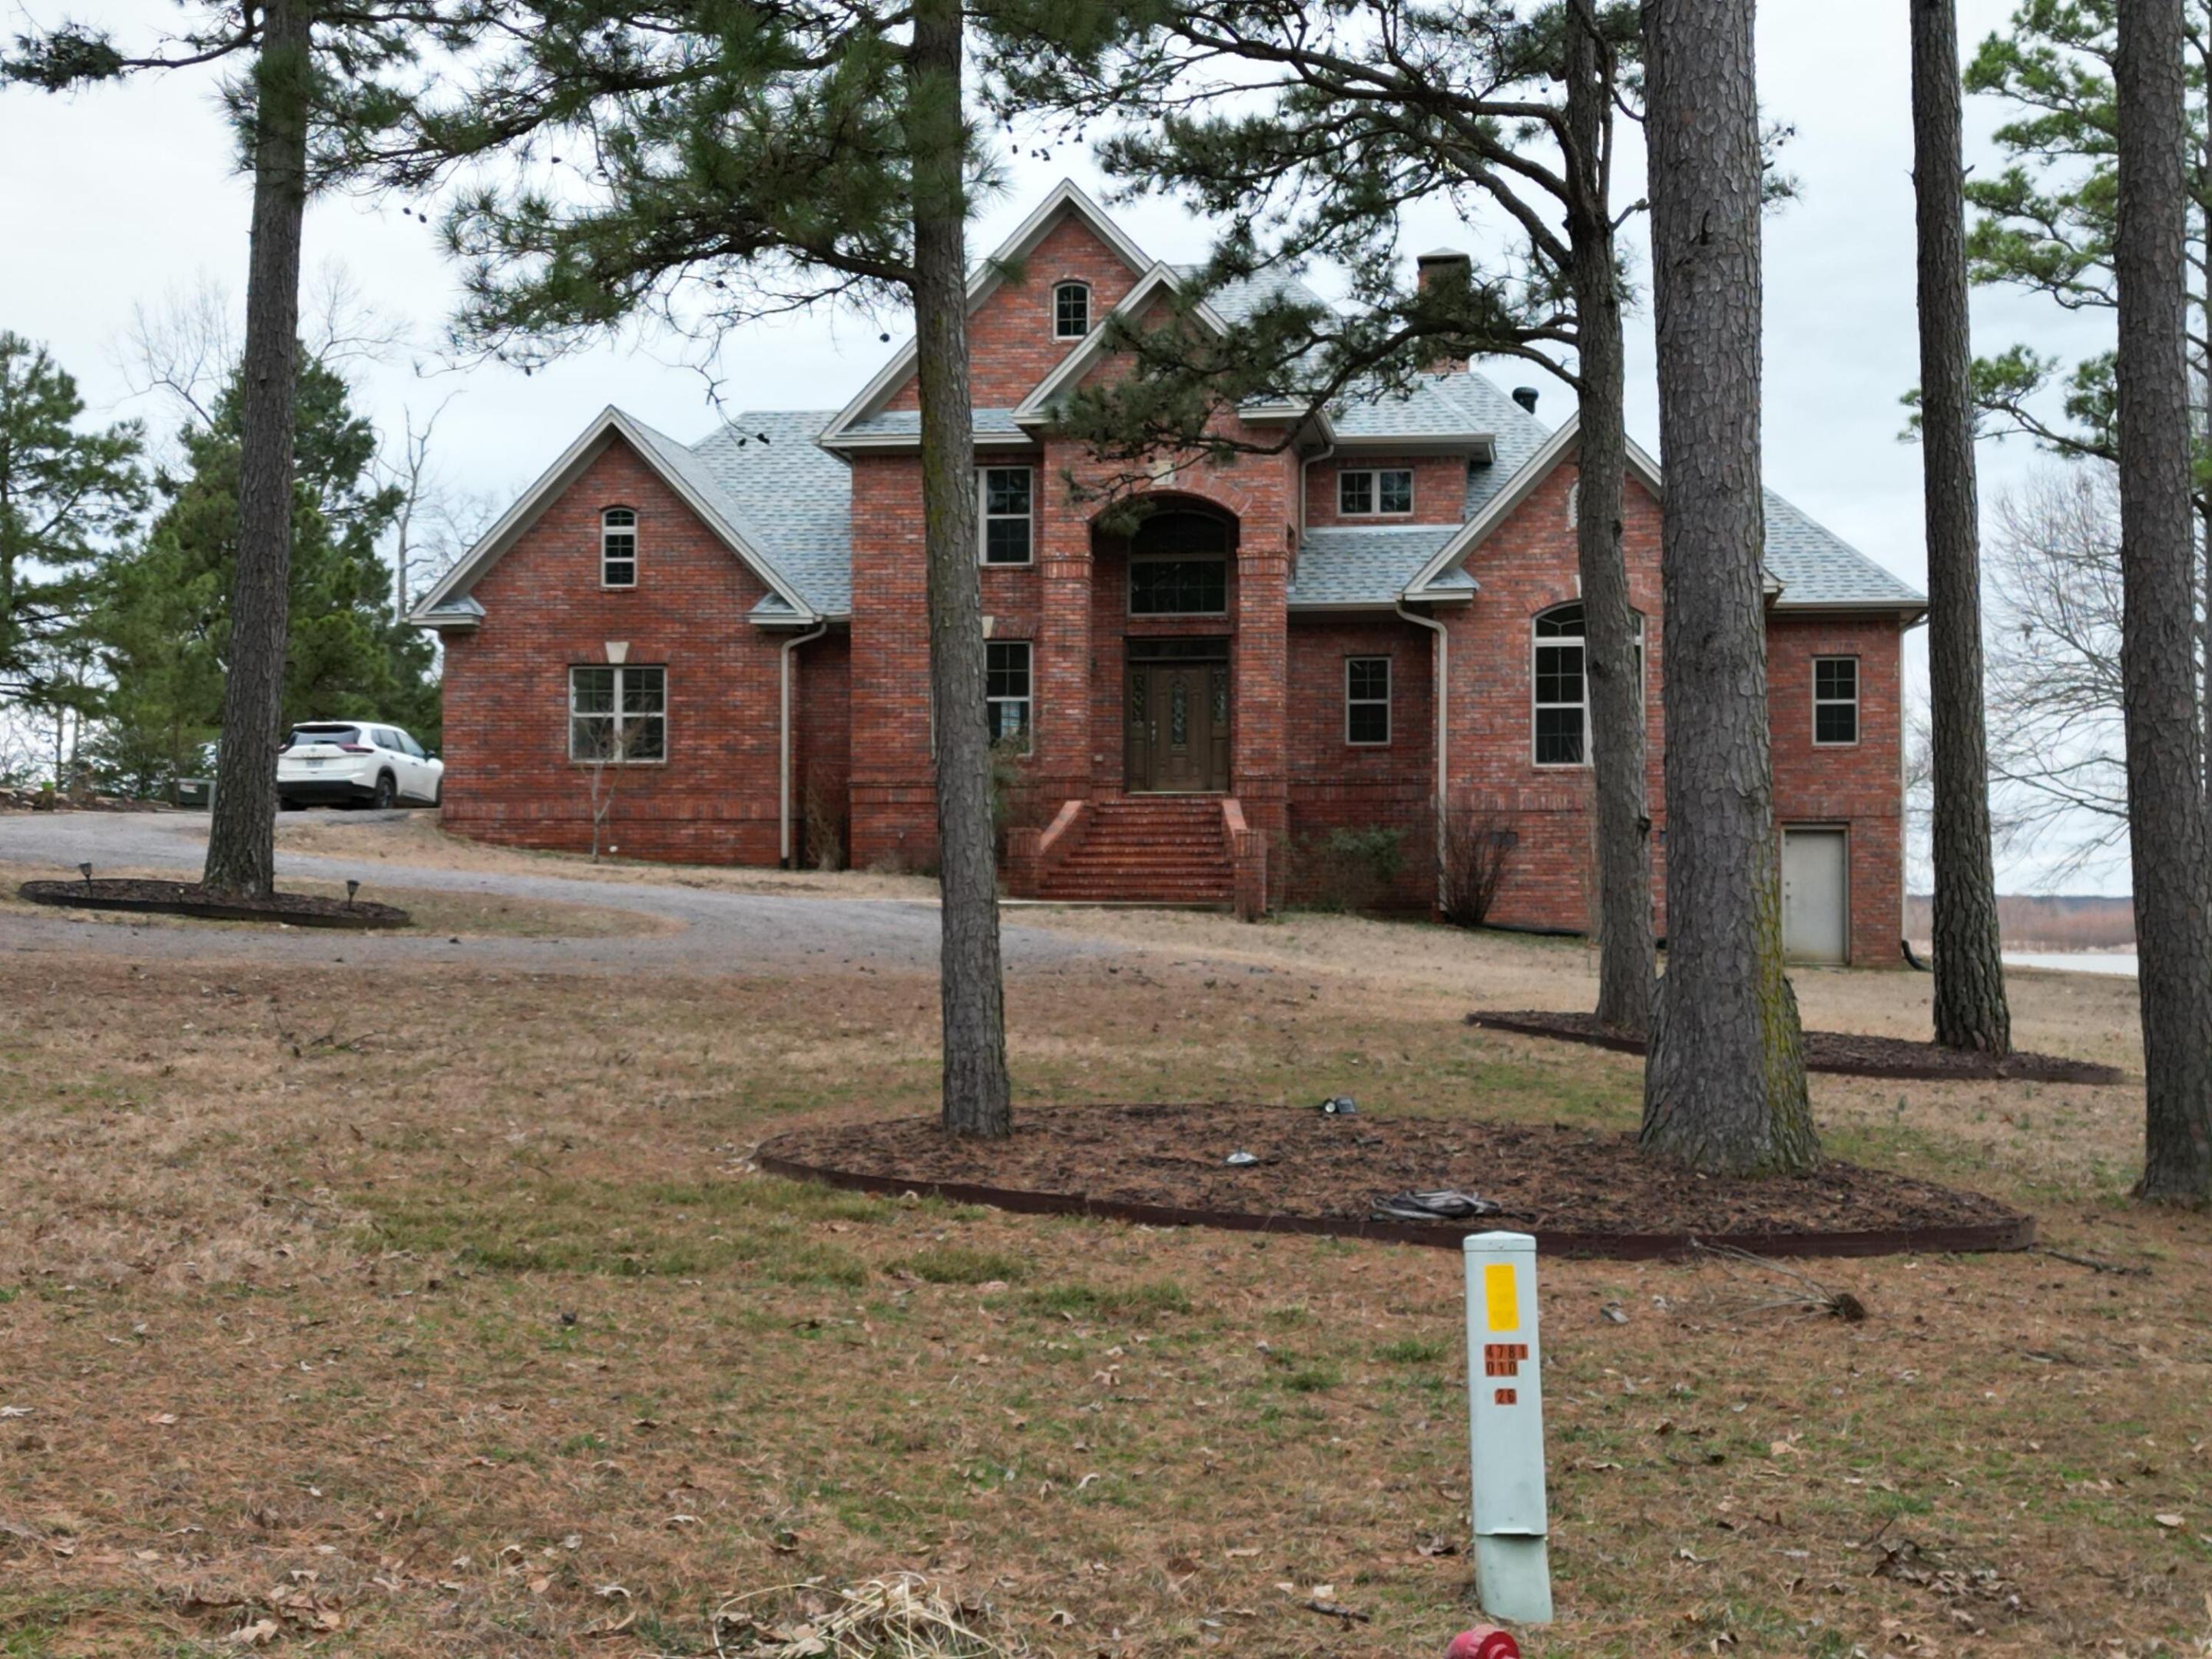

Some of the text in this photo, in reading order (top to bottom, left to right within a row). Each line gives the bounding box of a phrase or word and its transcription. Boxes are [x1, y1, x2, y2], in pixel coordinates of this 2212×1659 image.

[1485, 1344, 1525, 1359] 4781
[1486, 1360, 1516, 1376] 010
[1497, 1388, 1516, 1404] 26
